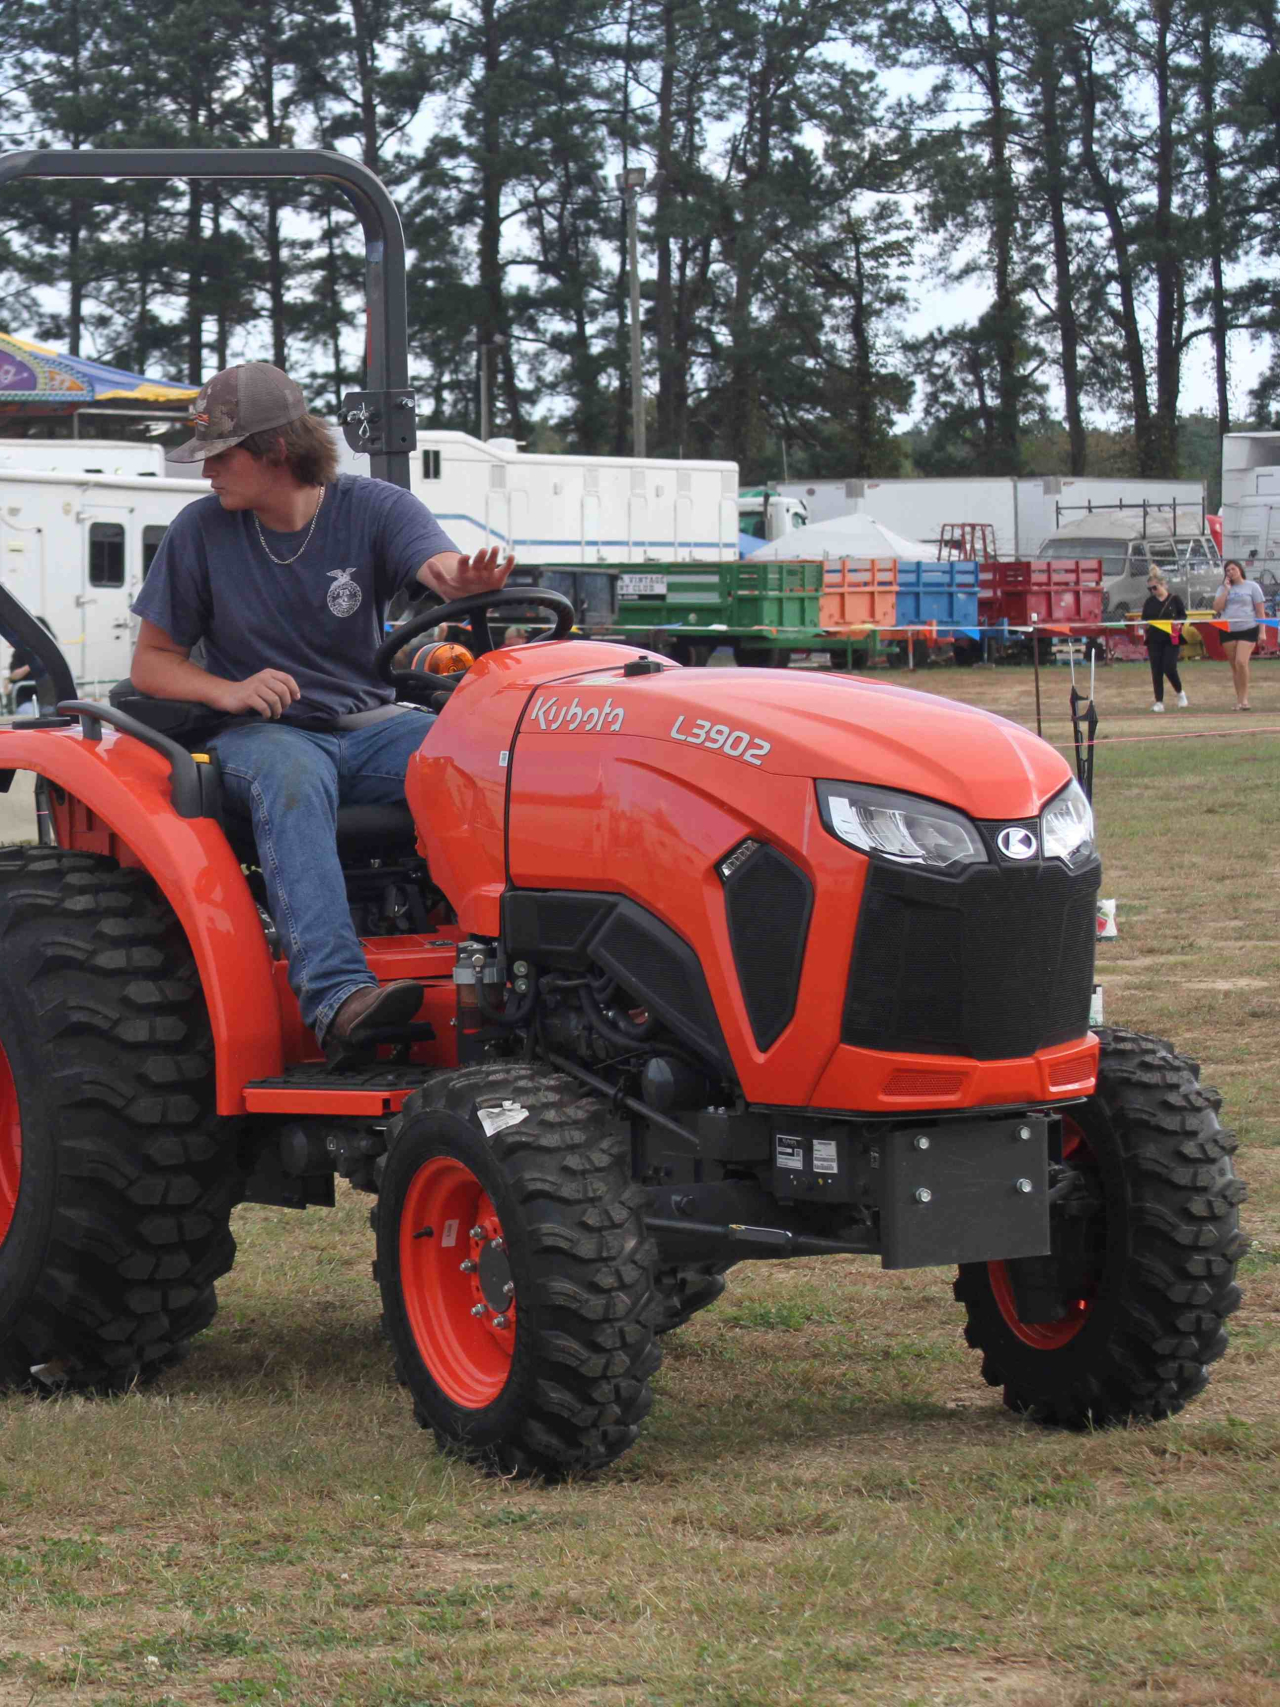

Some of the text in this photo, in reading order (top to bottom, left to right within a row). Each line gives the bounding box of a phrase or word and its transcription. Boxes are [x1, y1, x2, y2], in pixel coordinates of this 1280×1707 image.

[628, 576, 666, 584] VINTAGE
[530, 696, 625, 732] Kubota
[670, 715, 772, 766] L3902
